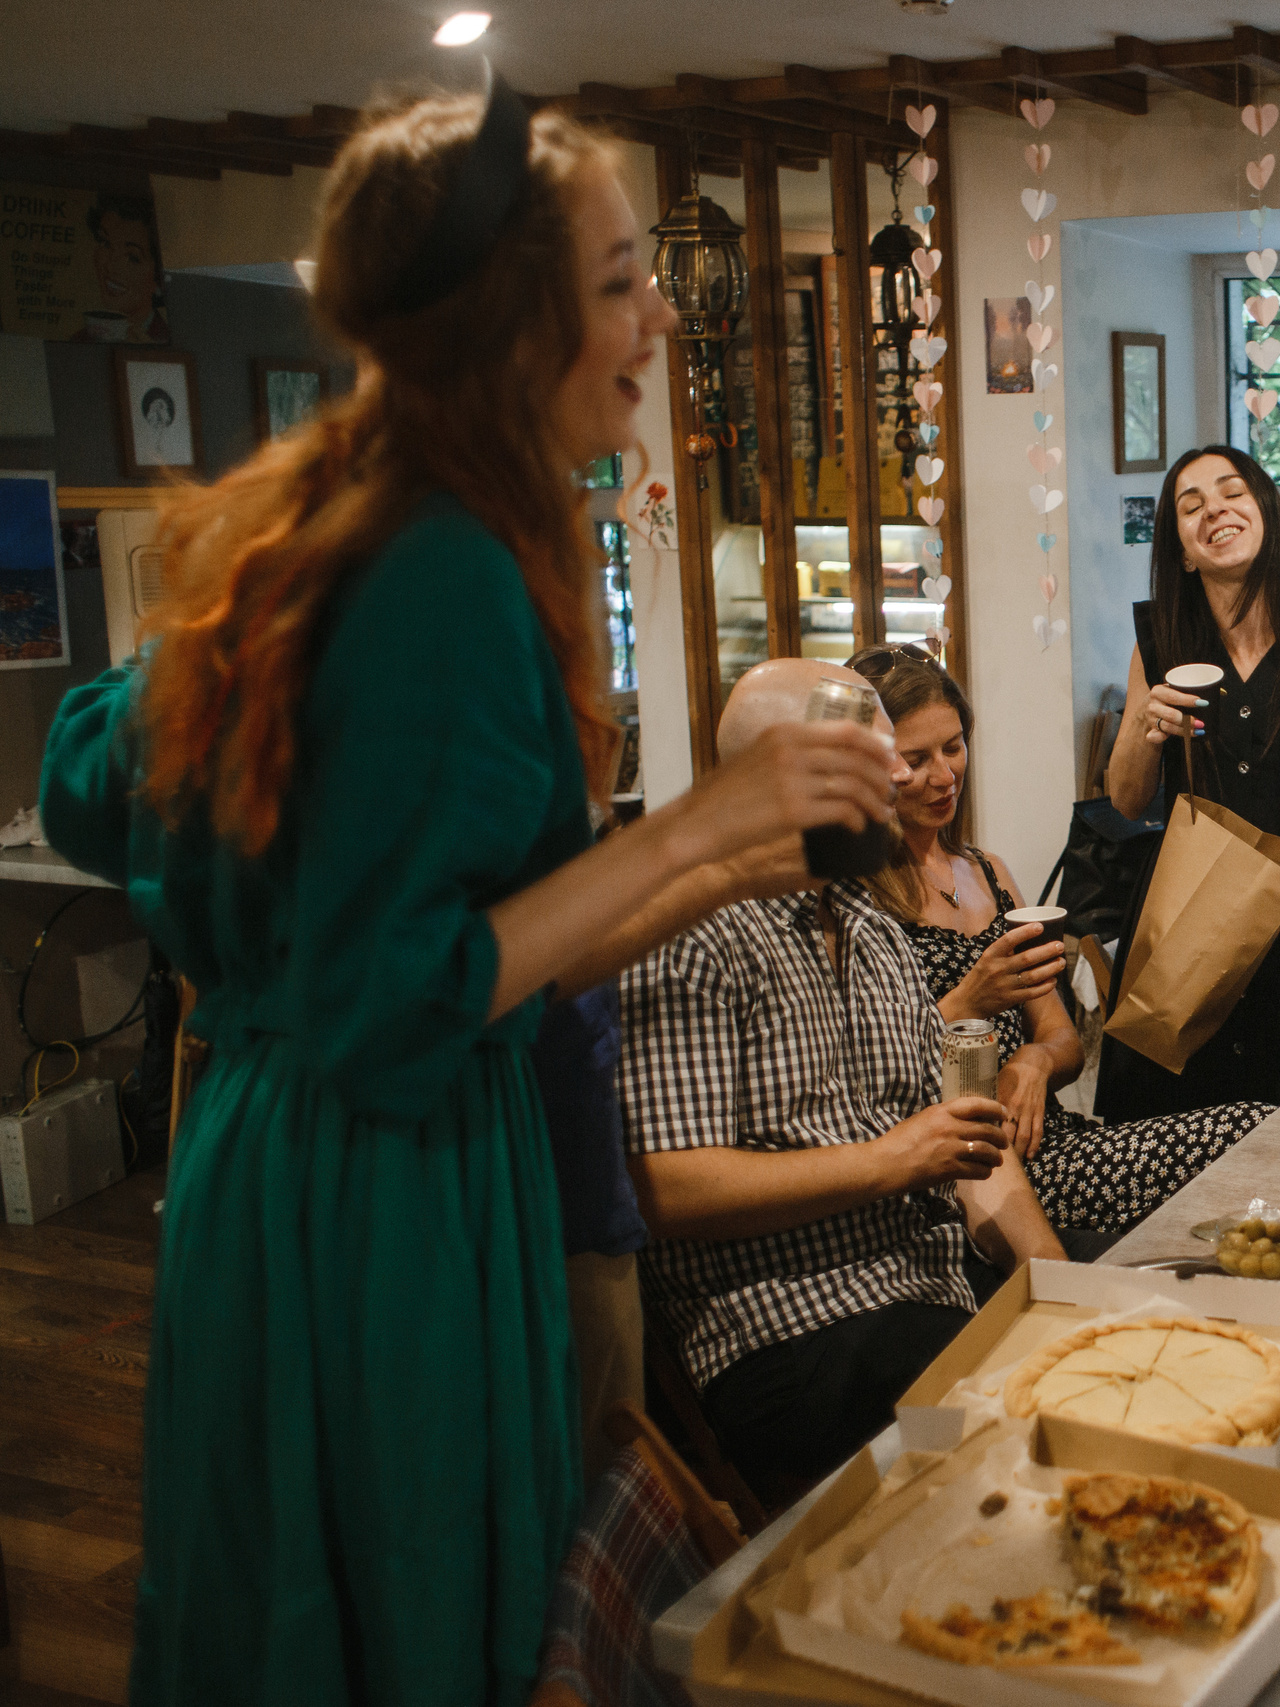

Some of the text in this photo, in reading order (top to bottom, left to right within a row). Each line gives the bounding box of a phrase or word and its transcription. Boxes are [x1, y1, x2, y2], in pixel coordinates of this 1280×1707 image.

[3, 194, 67, 218] DRINK
[0, 220, 75, 243] COFFEE
[11, 250, 71, 267] Do Stupid
[12, 265, 54, 280] Things
[15, 279, 52, 292] Faster
[17, 295, 75, 307] with More
[19, 308, 61, 326] Energy
